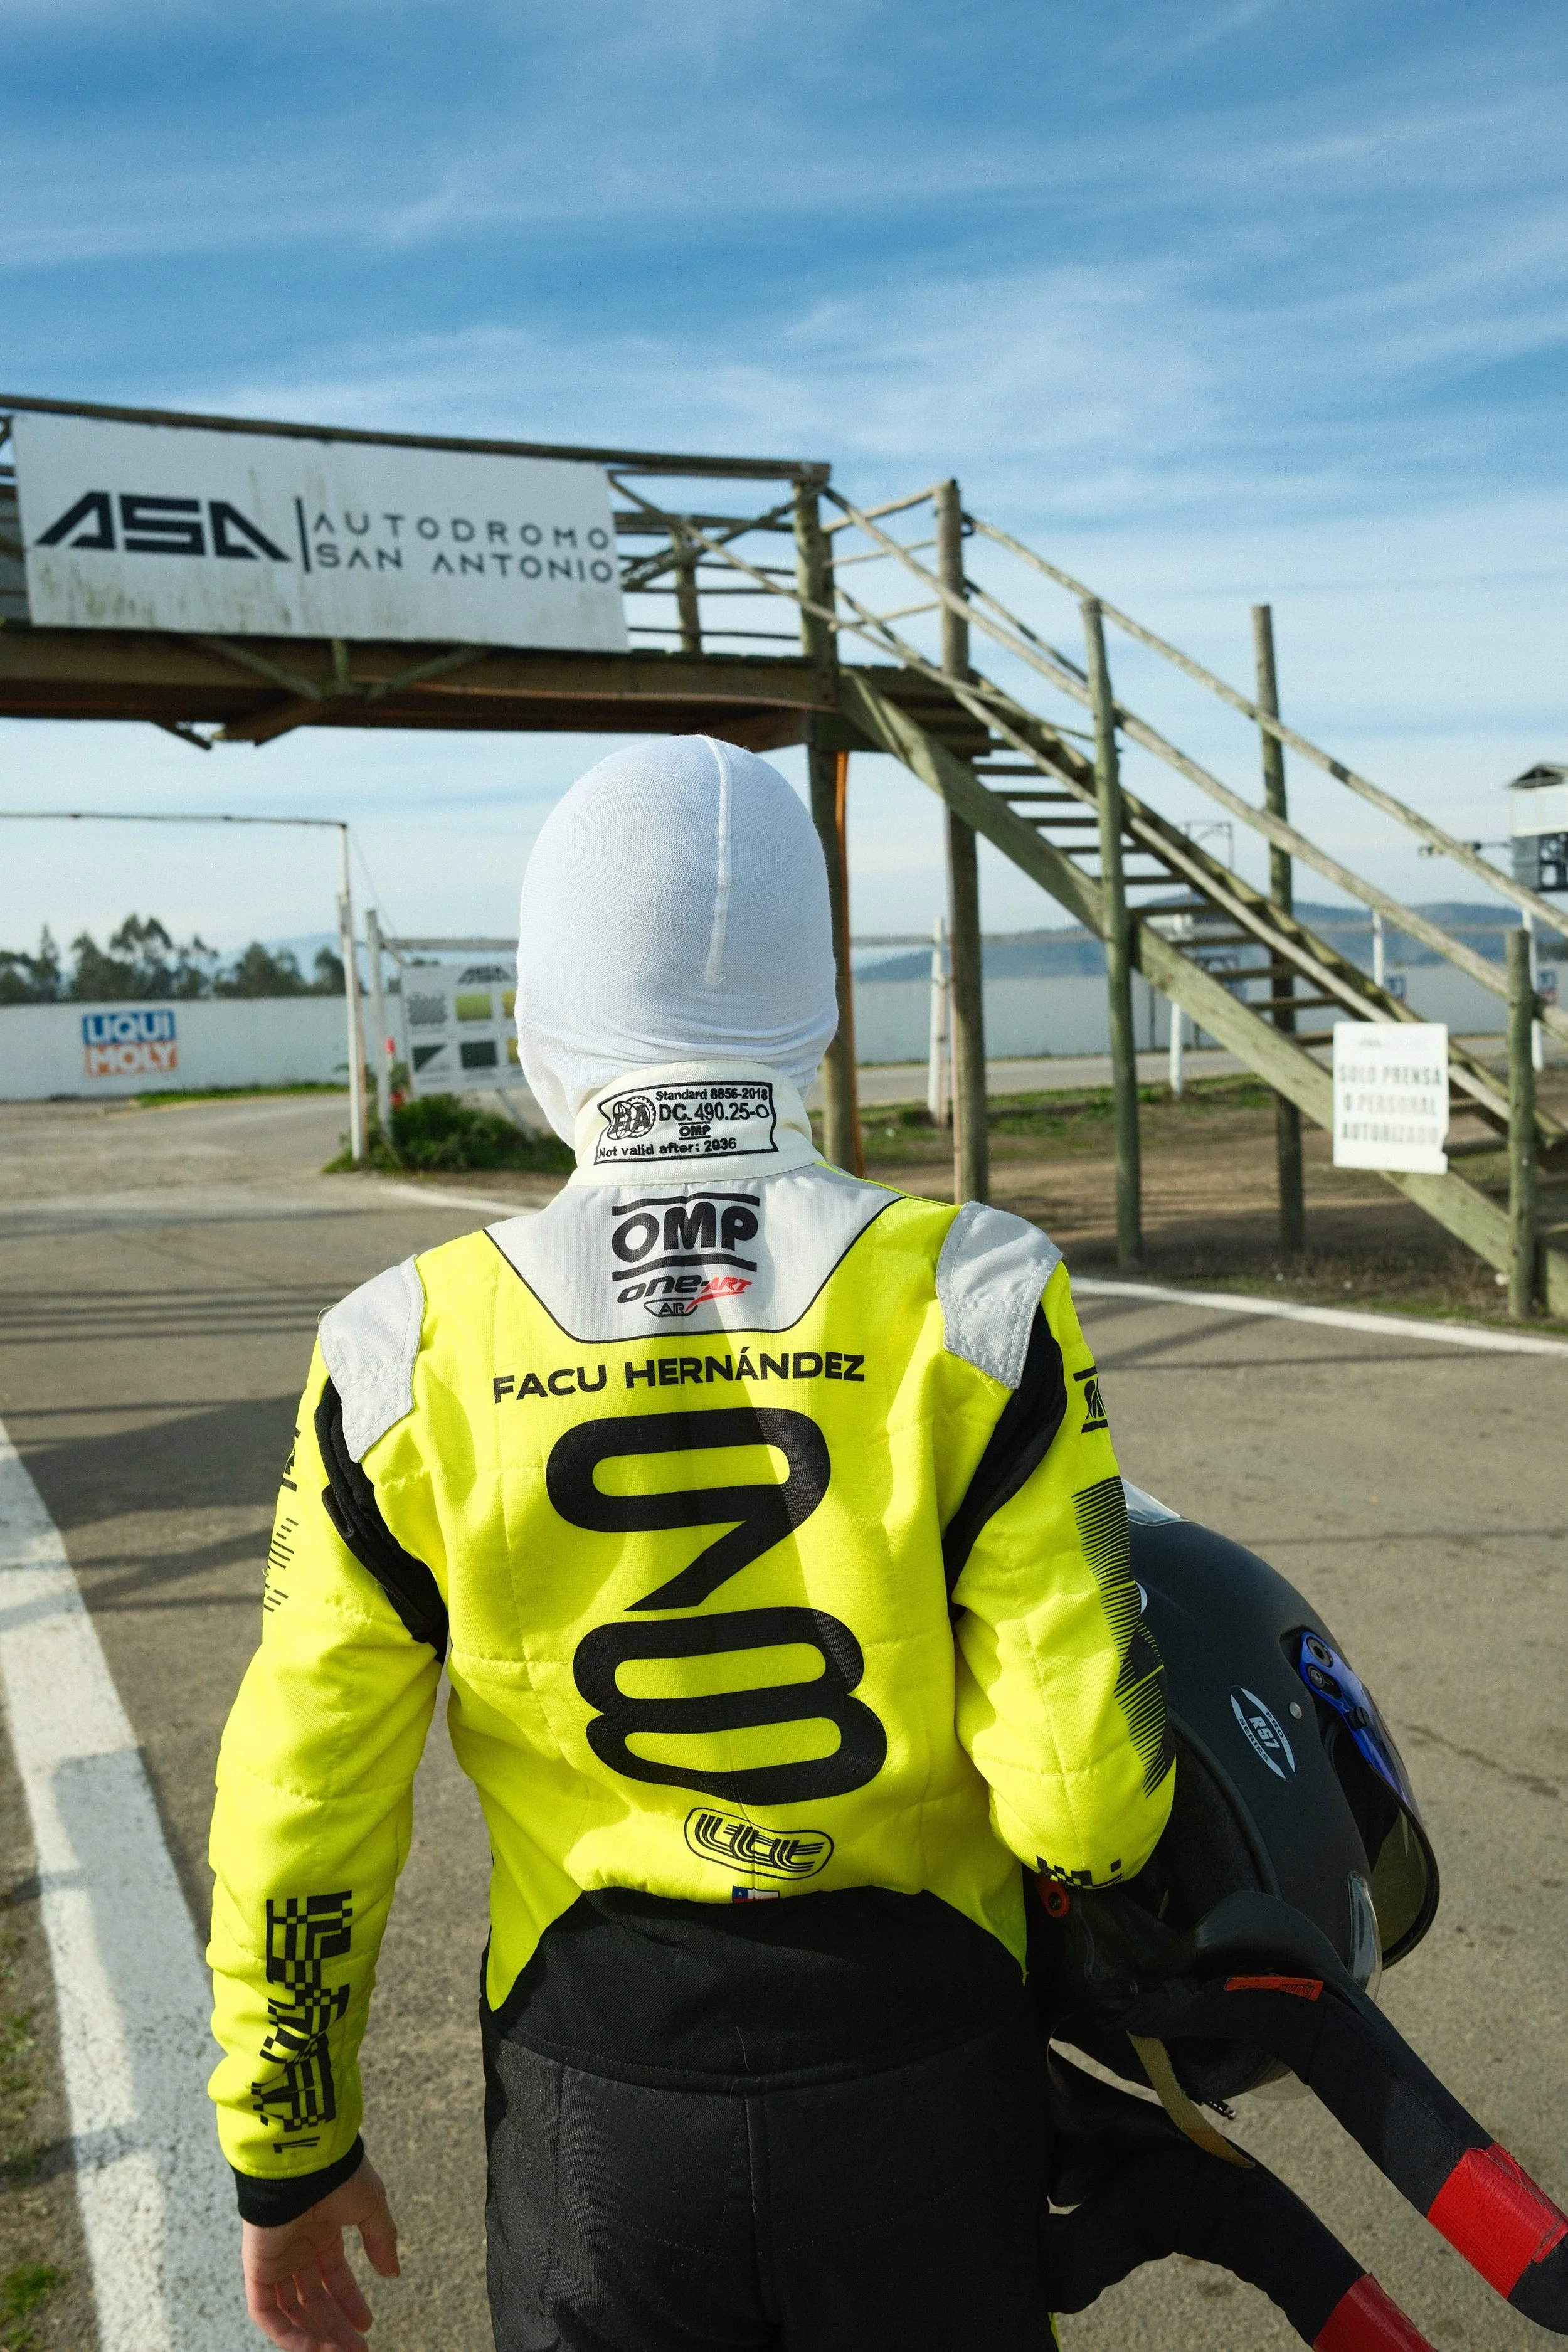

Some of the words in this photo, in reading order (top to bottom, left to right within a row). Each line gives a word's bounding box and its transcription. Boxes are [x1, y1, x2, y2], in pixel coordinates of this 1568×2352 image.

[313, 512, 609, 551] AUTODROMO
[317, 543, 402, 571] SAN
[432, 554, 612, 584] ANTONIO
[87, 1015, 170, 1044] LIQUI
[90, 1042, 176, 1074] MOLY
[655, 1089, 708, 1101] Standard
[710, 1088, 768, 1101] 8856-2018
[679, 1124, 711, 1136] OMP
[598, 1146, 618, 1158] Not
[622, 1143, 654, 1155] valid
[659, 1142, 700, 1154] after:
[704, 1137, 737, 1152] 2036
[612, 1202, 758, 1263] OMP
[493, 1364, 607, 1404] FACU
[625, 1347, 865, 1389] HERNÁNDEZ
[1239, 1718, 1268, 1761] SERIES
[1265, 1711, 1284, 1739] PRO
